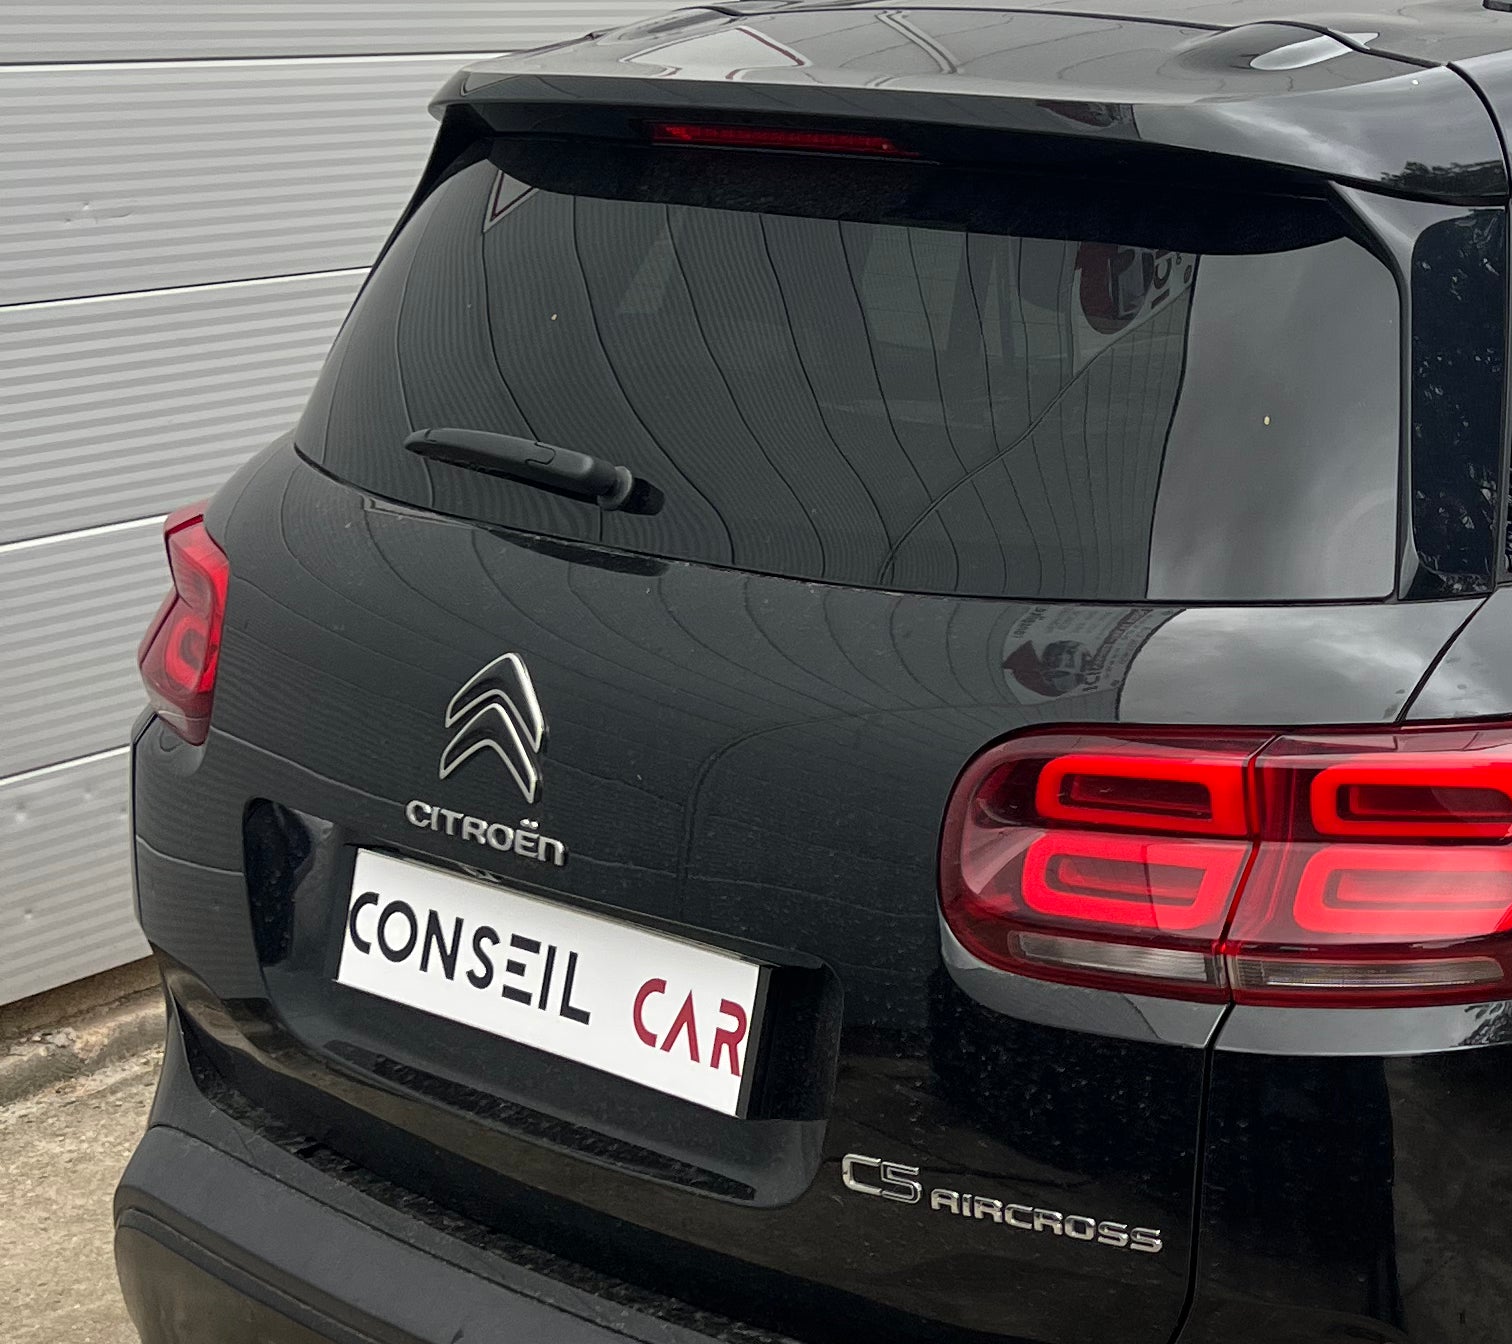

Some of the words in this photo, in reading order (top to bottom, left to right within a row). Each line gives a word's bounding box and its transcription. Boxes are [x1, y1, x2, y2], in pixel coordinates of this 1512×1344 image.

[404, 799, 566, 867] CITROËN
[349, 890, 591, 1025] CONSEIL
[632, 977, 747, 1077] CAR
[841, 1153, 923, 1204] C5
[930, 1188, 1163, 1253] AIRCROSS
